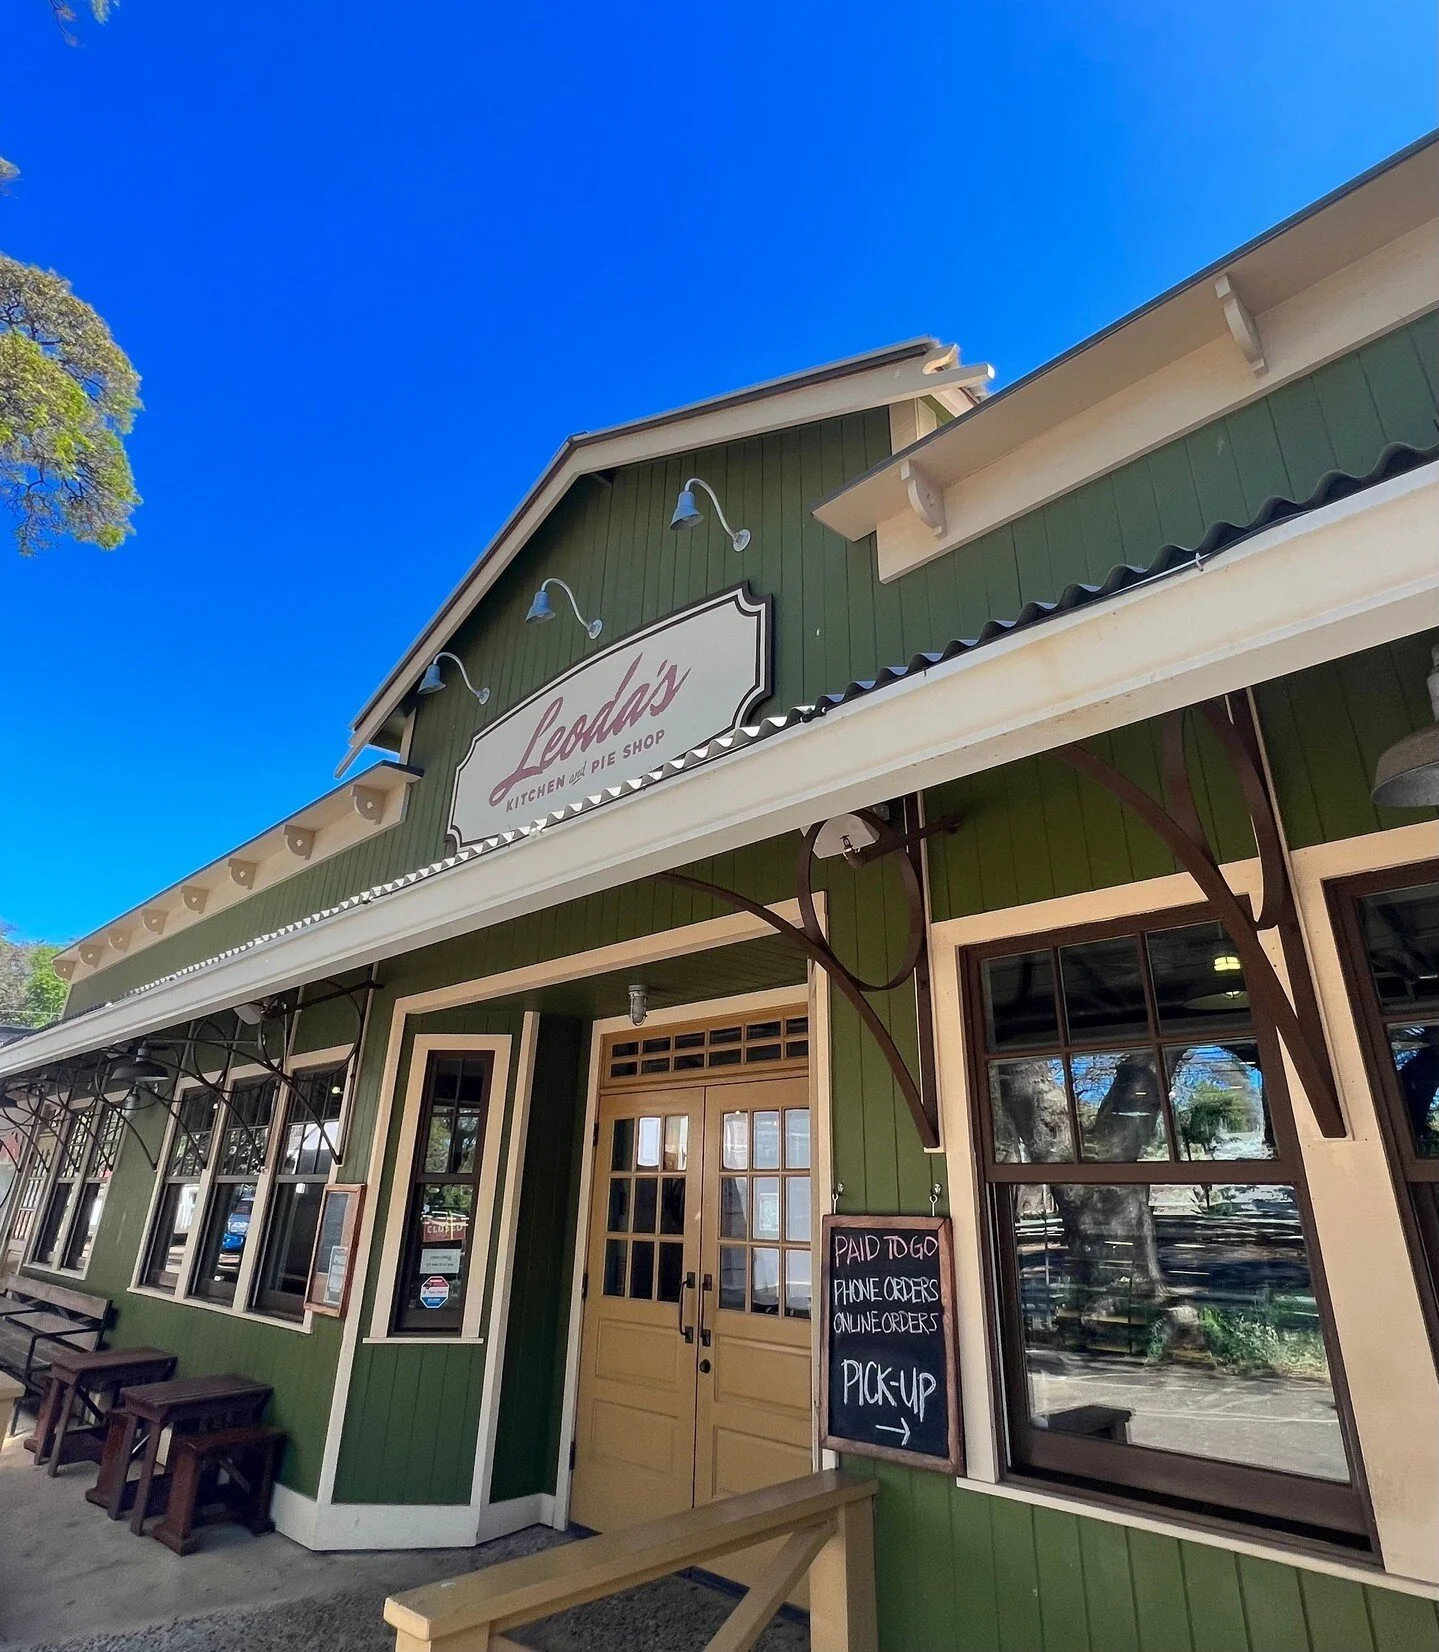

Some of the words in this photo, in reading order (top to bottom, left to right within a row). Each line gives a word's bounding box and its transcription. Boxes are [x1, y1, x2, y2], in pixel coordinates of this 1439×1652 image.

[489, 652, 691, 807] Leoda's
[506, 775, 565, 812] KITCHEN
[569, 760, 587, 786] and
[591, 754, 615, 774] PIE
[623, 729, 665, 759] SHOP
[834, 1235, 880, 1267] PAID
[834, 1277, 882, 1306] PHONE
[883, 1277, 938, 1303] ORDERS
[834, 1310, 882, 1334] ONLINE
[882, 1312, 938, 1334] ORDERS
[841, 1359, 936, 1422] PICK-UP
